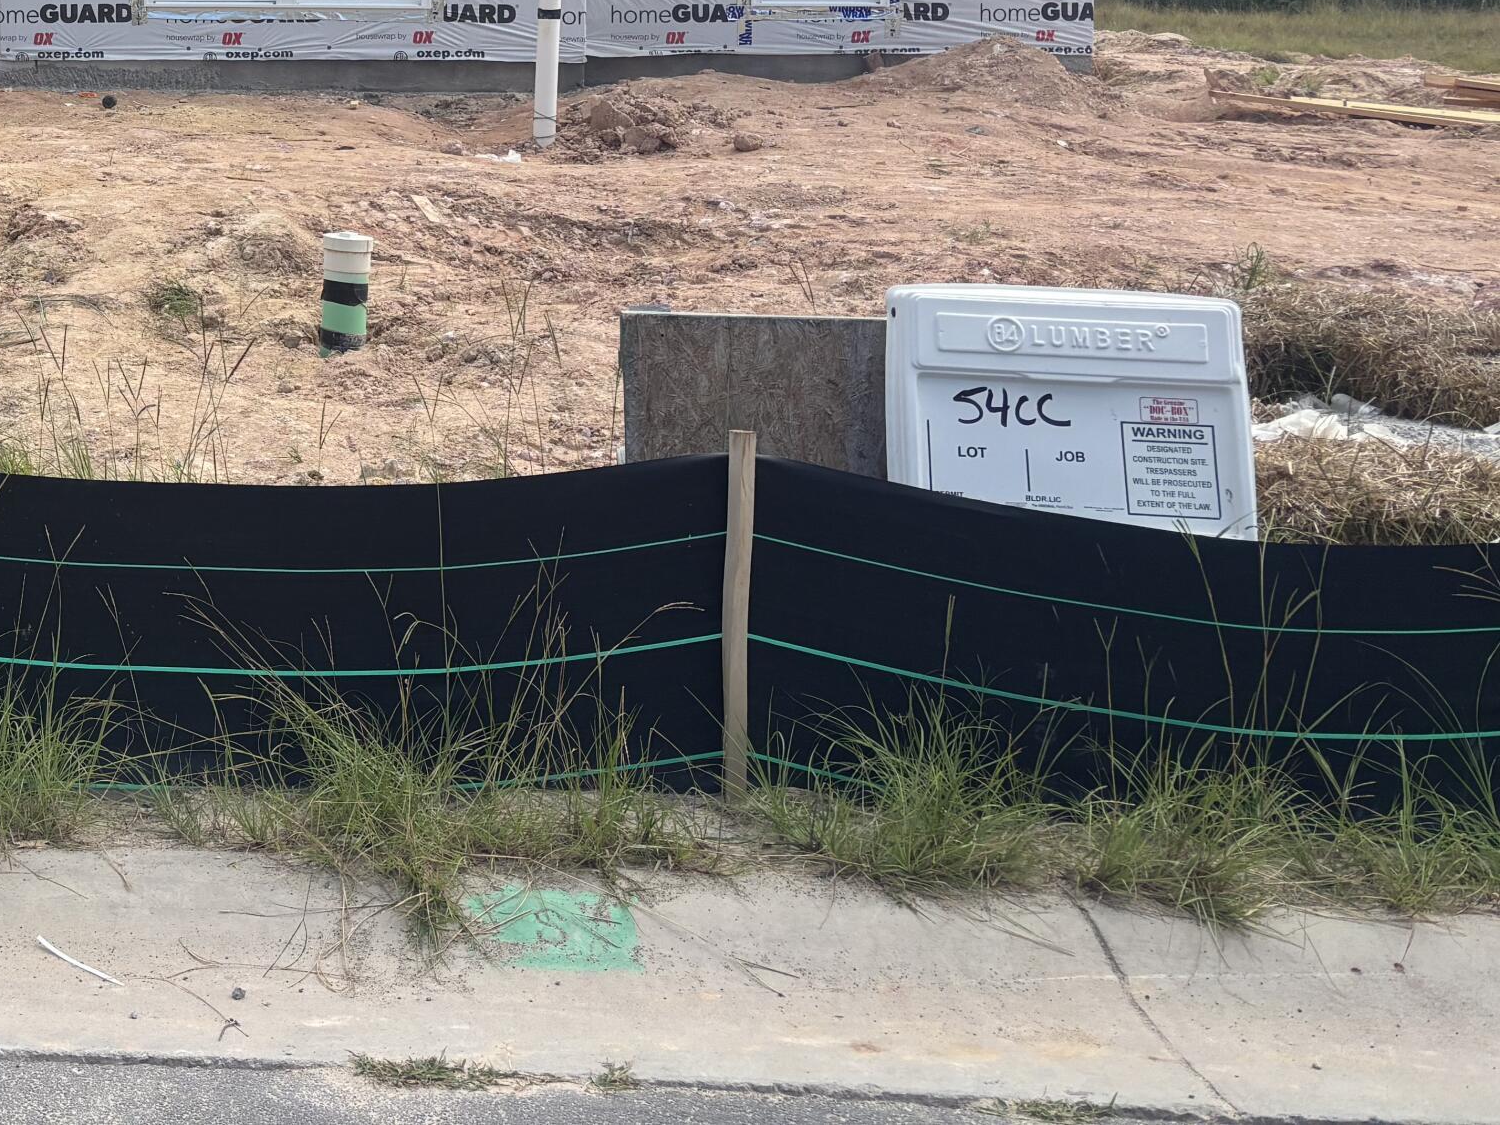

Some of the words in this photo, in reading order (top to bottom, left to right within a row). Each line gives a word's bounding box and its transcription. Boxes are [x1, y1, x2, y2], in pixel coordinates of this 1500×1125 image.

[34, 32, 55, 46] OX
[221, 32, 243, 46] OX
[412, 30, 434, 44] OX
[665, 31, 686, 45] OX
[851, 30, 871, 44] OX
[1035, 30, 1056, 42] OX
[37, 49, 105, 60] oxep.com
[225, 49, 294, 60] oxep.com
[416, 48, 485, 59] oxep.com
[1030, 324, 1156, 352] LUMBER
[1131, 426, 1205, 440] WARNING
[957, 445, 987, 459] LOT
[1146, 445, 1192, 454] DESIGNATED
[1055, 450, 1086, 463] JOB
[1132, 455, 1189, 465] CONSTRUCTION
[1145, 466, 1198, 477] TRESPASSERS
[1132, 477, 1150, 486] WILL
[1162, 479, 1213, 489] PROSECUTED
[1150, 489, 1161, 497] TO
[1162, 490, 1176, 498] THE
[1177, 491, 1196, 499] FULL
[1136, 499, 1165, 508] EXTENT
